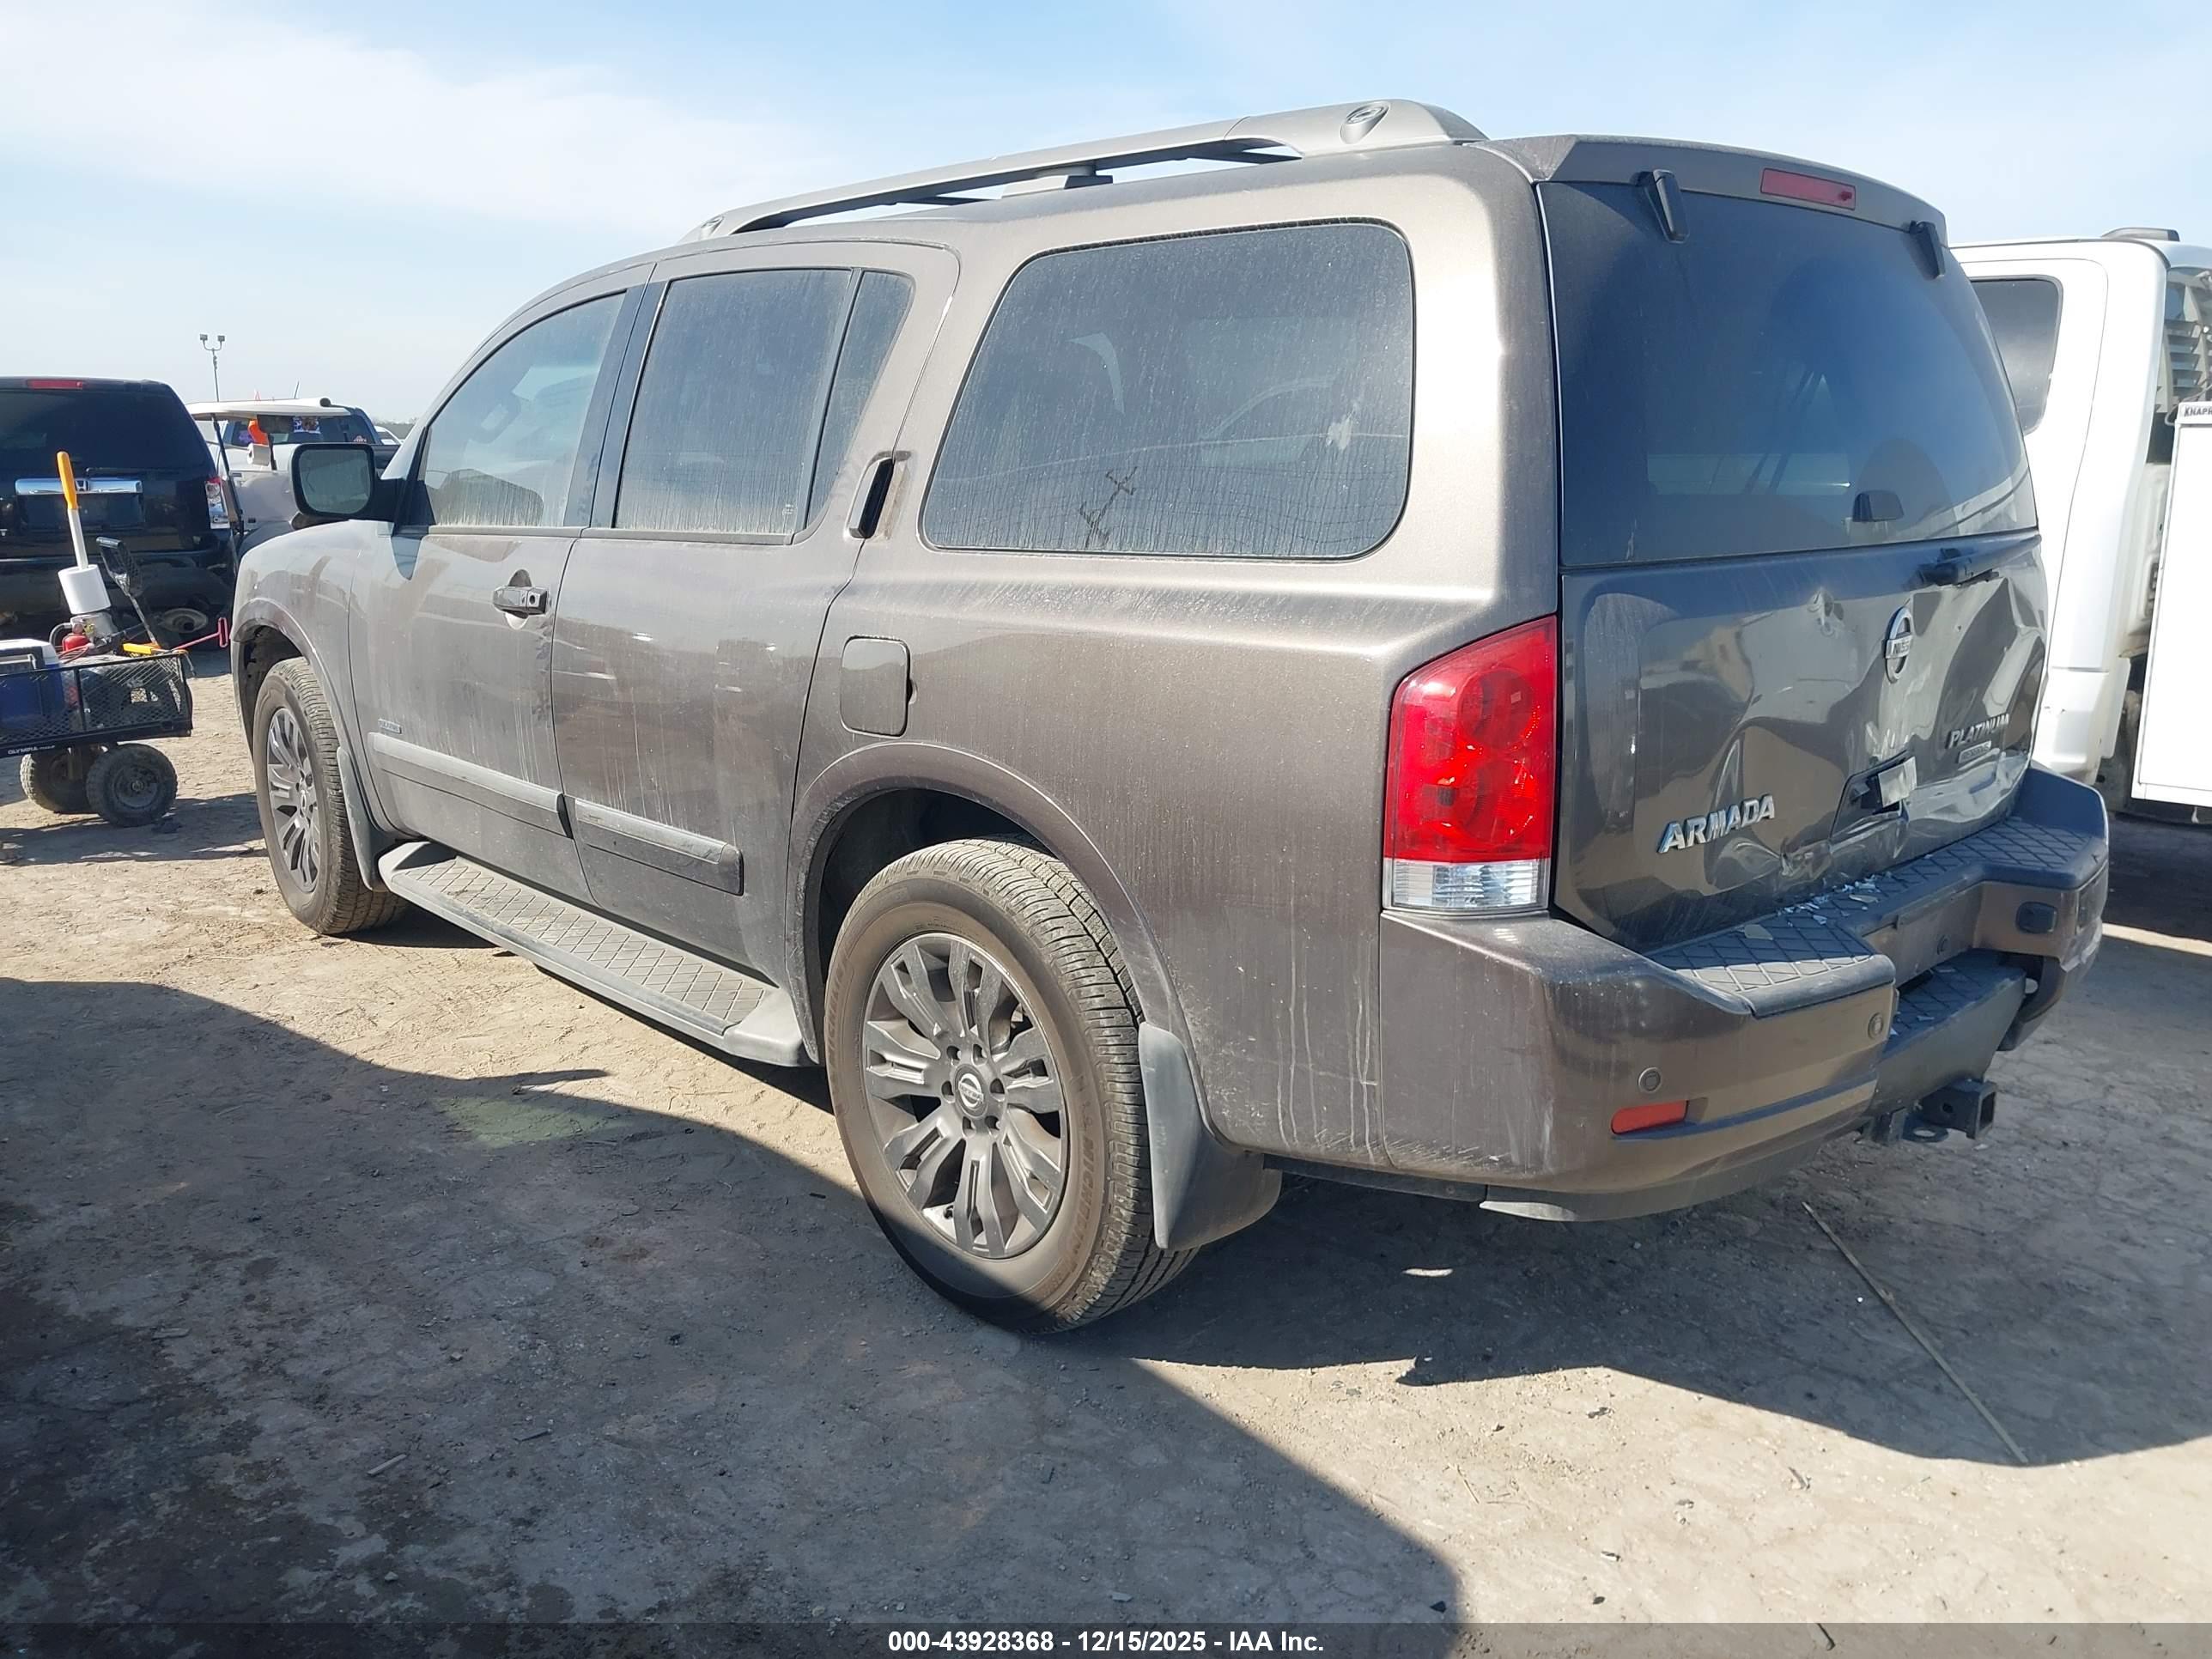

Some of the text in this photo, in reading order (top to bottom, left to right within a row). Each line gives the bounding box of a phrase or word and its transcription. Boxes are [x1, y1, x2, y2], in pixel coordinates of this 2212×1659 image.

[8, 746, 38, 755] OLYMPIA
[1948, 714, 2009, 749] PLATINUM
[1657, 794, 1775, 854] ARMADA
[1073, 1135, 1096, 1255] MICHELIN
